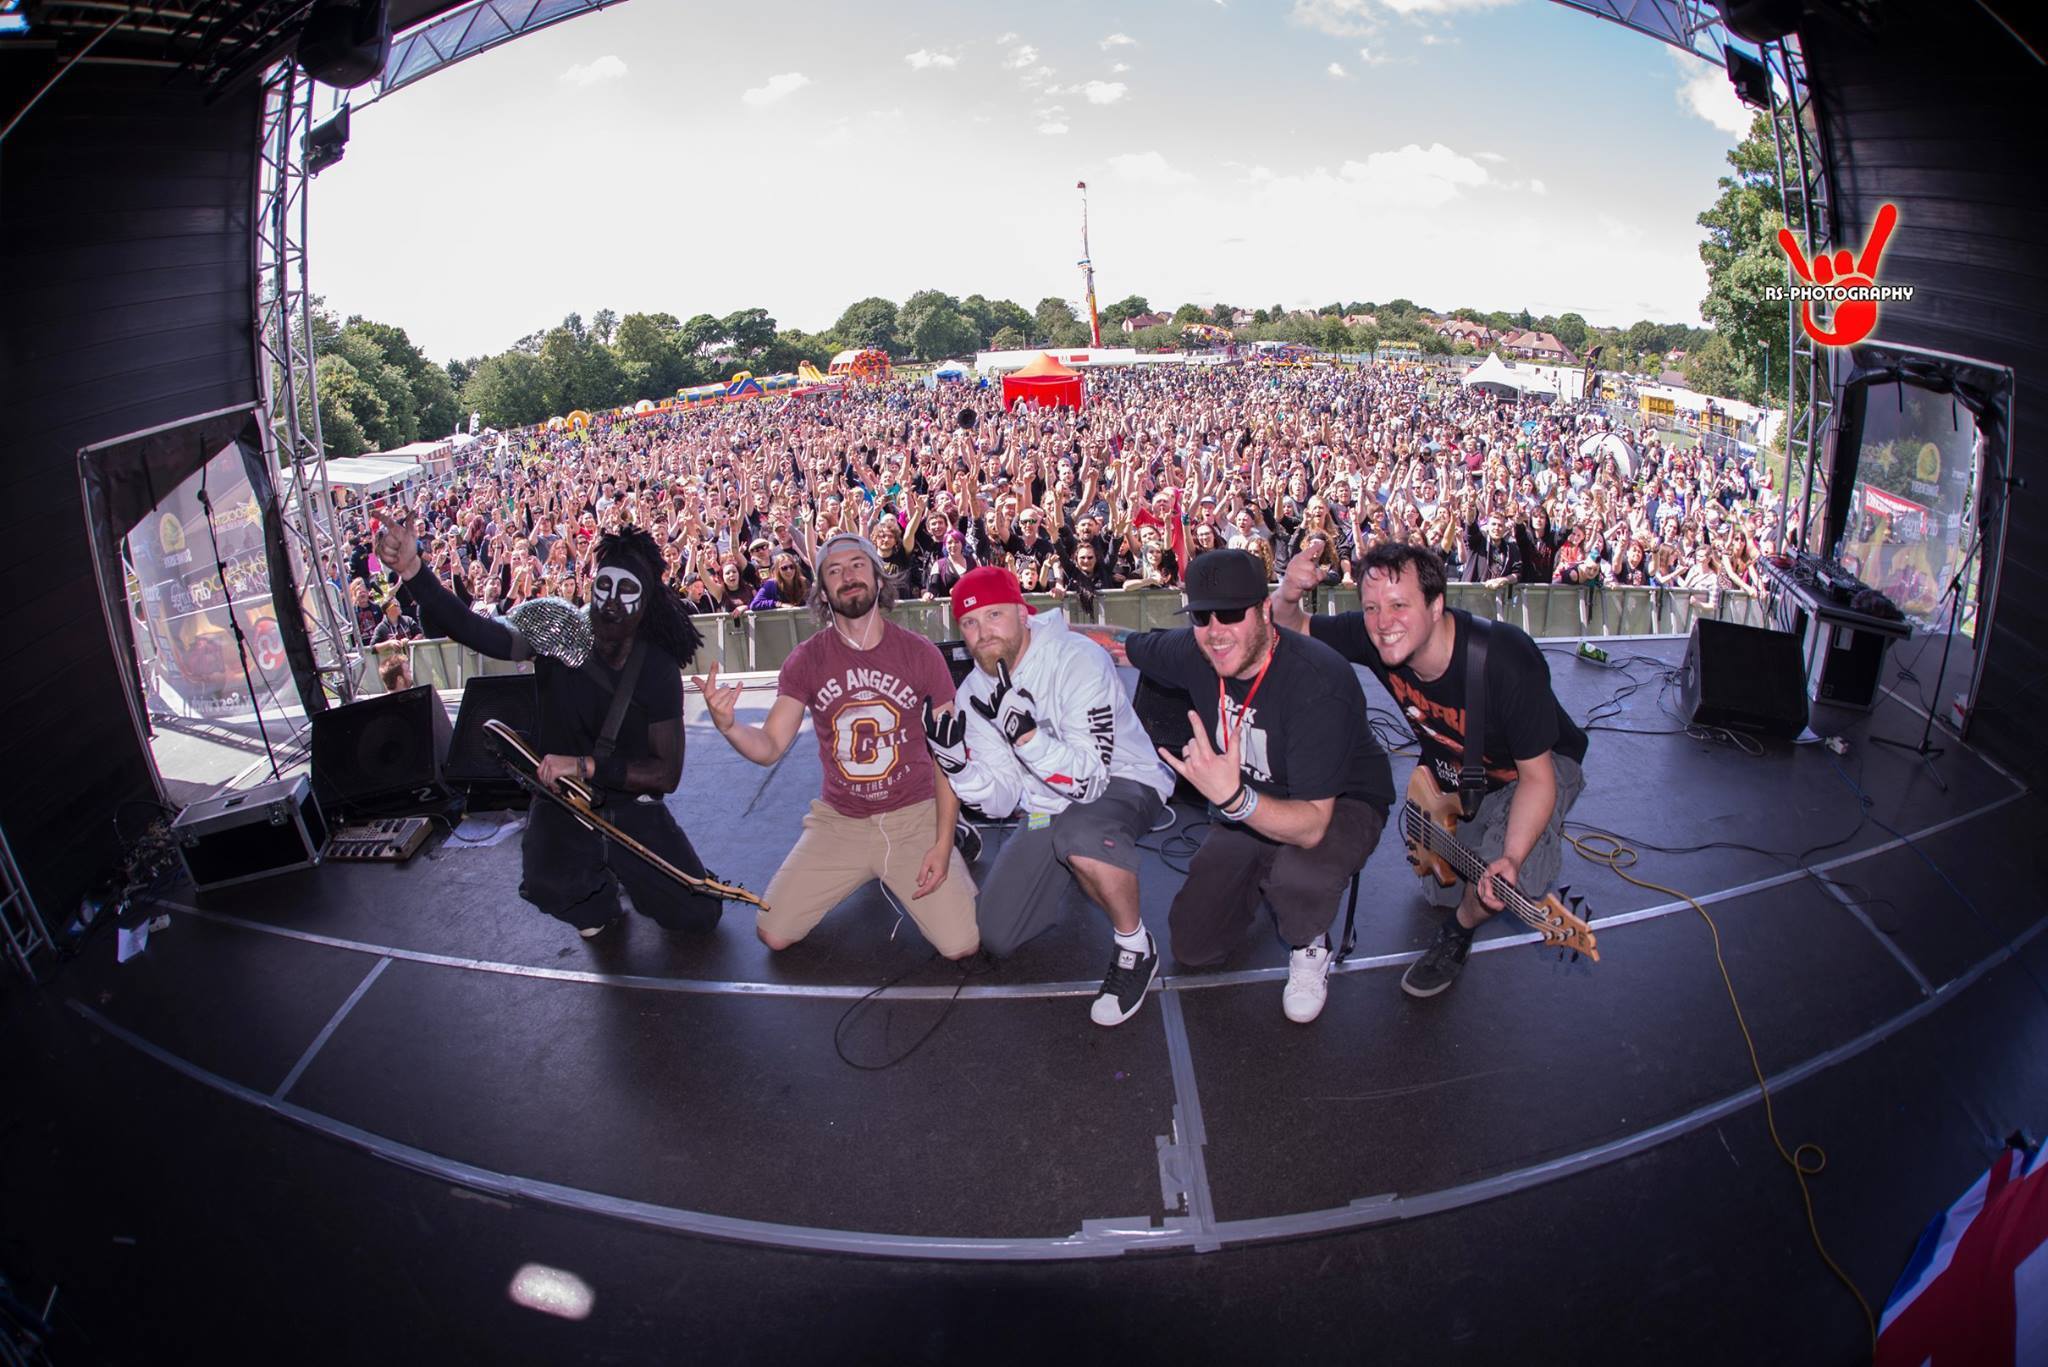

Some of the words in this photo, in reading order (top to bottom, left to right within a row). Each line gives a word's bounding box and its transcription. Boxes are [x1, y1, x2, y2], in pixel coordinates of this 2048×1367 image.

[815, 678, 843, 712] LOS
[846, 667, 918, 710] ANGELES
[866, 779, 884, 793] THE
